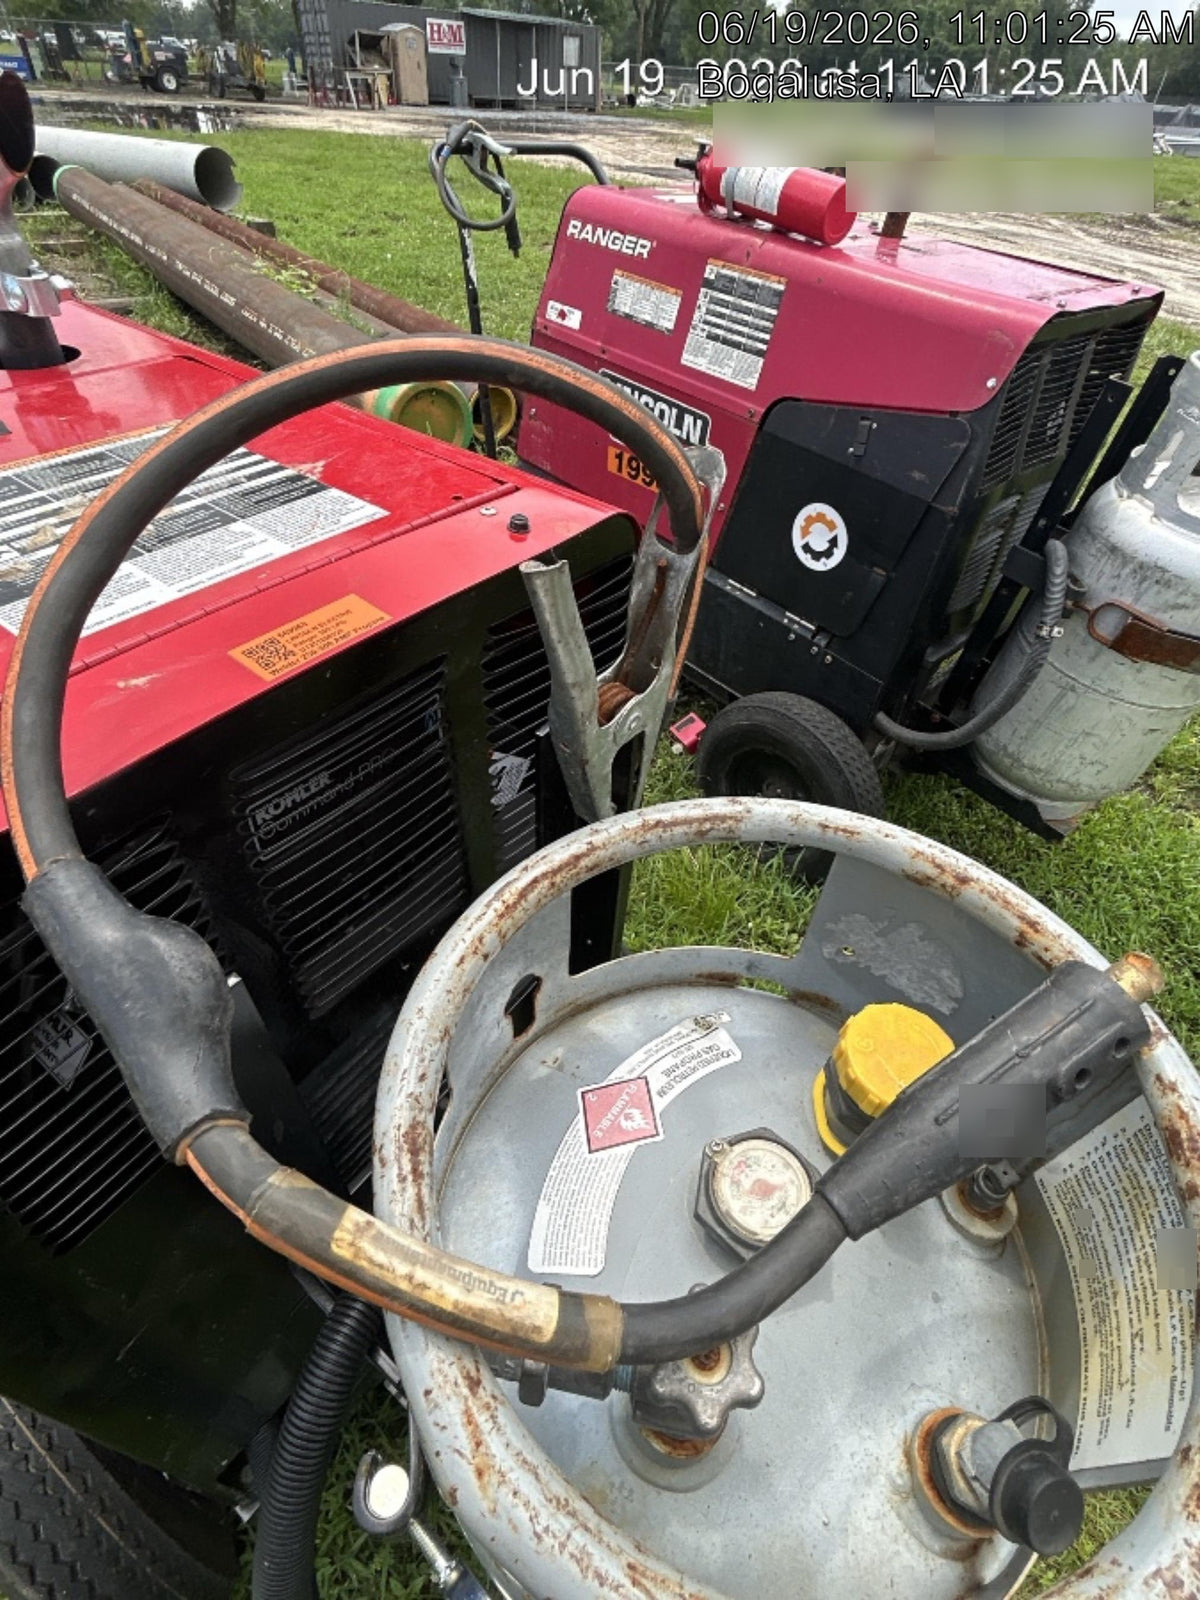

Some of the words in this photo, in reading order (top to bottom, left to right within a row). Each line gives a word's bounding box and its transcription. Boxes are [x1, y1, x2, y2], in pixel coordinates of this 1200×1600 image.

[429, 22, 464, 43] H&M
[567, 220, 652, 259] RANGER
[253, 770, 335, 827] KOHLER
[593, 1083, 639, 1139] FLAMMABLE
